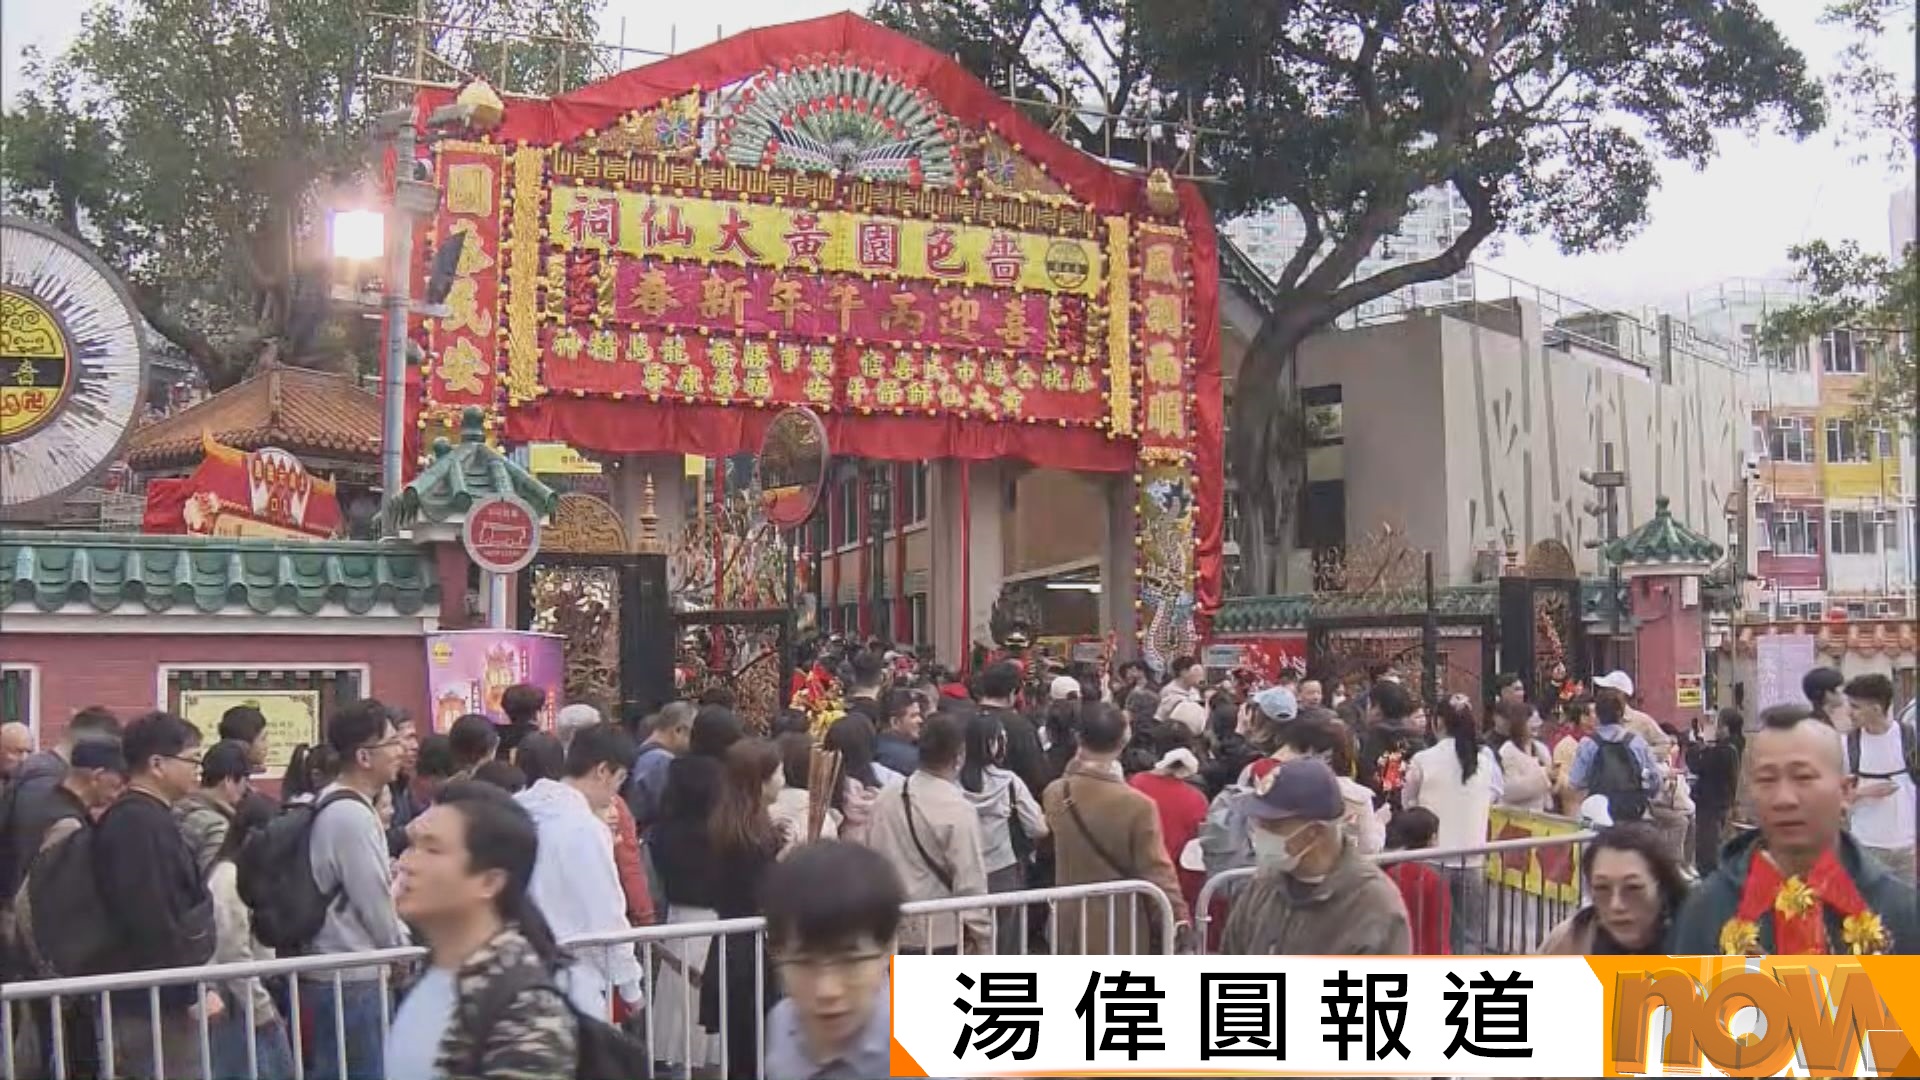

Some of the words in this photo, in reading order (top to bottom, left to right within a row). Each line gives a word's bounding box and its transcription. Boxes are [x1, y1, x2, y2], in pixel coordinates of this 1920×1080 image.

[564, 194, 1027, 286] 嗇色園黃大仙祠
[629, 268, 1038, 346] 喜迎丙午年新春
